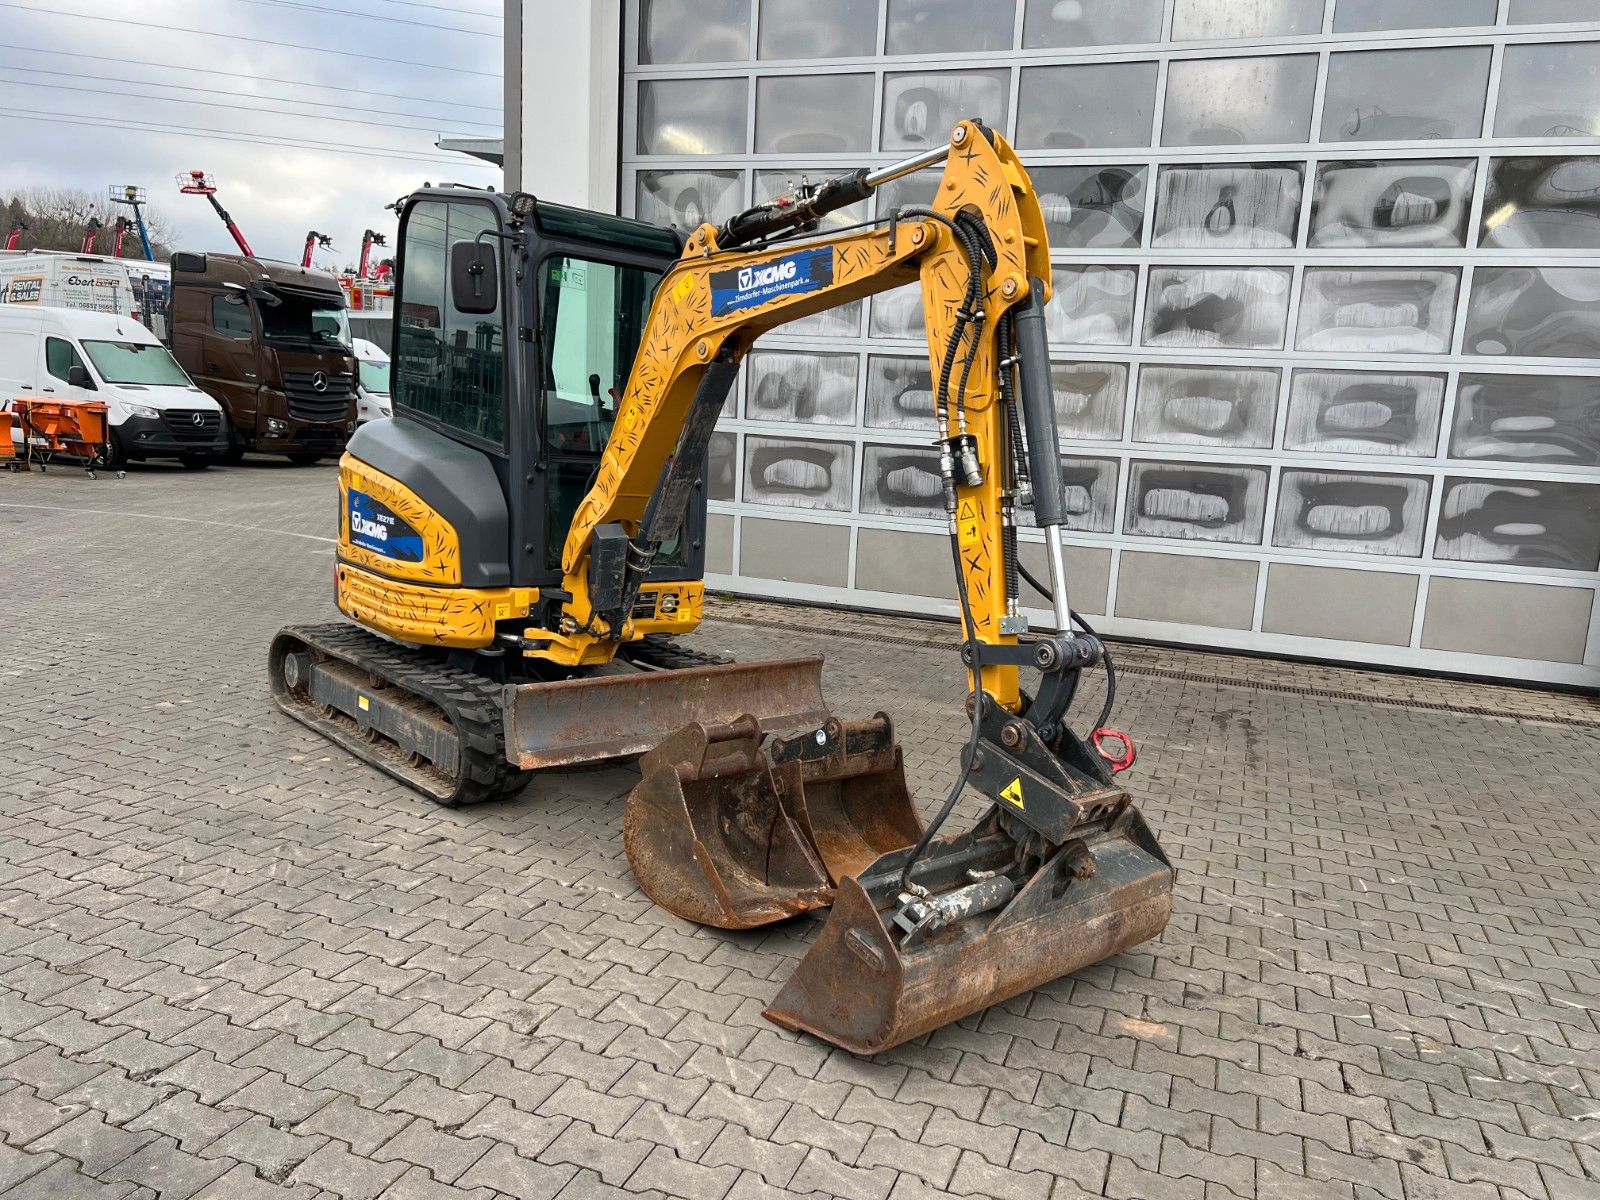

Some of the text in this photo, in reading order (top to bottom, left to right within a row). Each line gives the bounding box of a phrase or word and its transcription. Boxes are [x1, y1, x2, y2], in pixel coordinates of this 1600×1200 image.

[68, 276, 95, 286] Ebert
[752, 261, 797, 287] XCMG
[13, 280, 41, 290] RENTAL
[361, 519, 388, 541] XCMG
